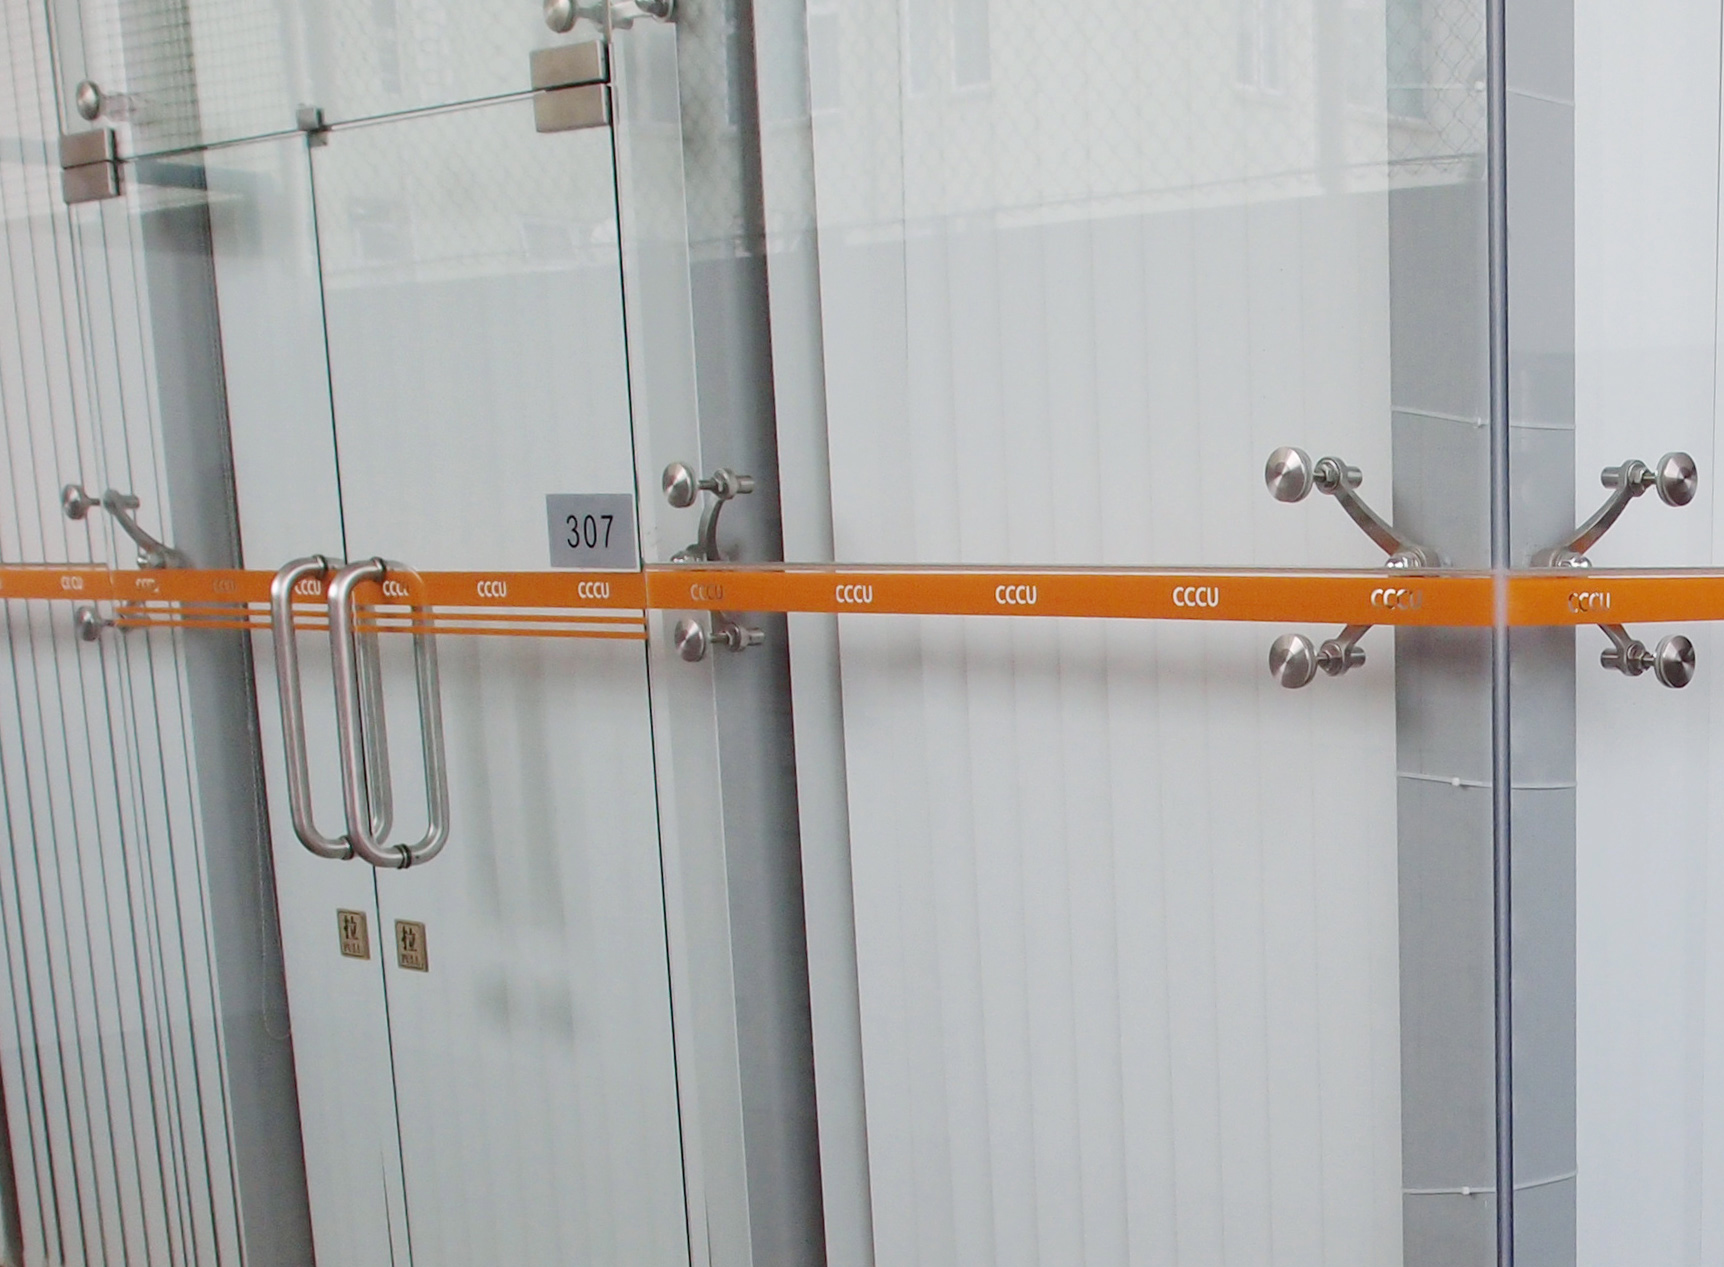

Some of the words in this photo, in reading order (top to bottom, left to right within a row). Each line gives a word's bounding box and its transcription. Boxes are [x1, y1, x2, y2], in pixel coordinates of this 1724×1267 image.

[566, 514, 614, 548] 307
[477, 580, 507, 597] CCCU
[578, 581, 610, 599] CCCU
[835, 585, 873, 603] CCCU
[995, 585, 1038, 605] CCCU
[1172, 586, 1220, 608] CCCU
[343, 915, 359, 940] 拉
[401, 925, 418, 951] 拉
